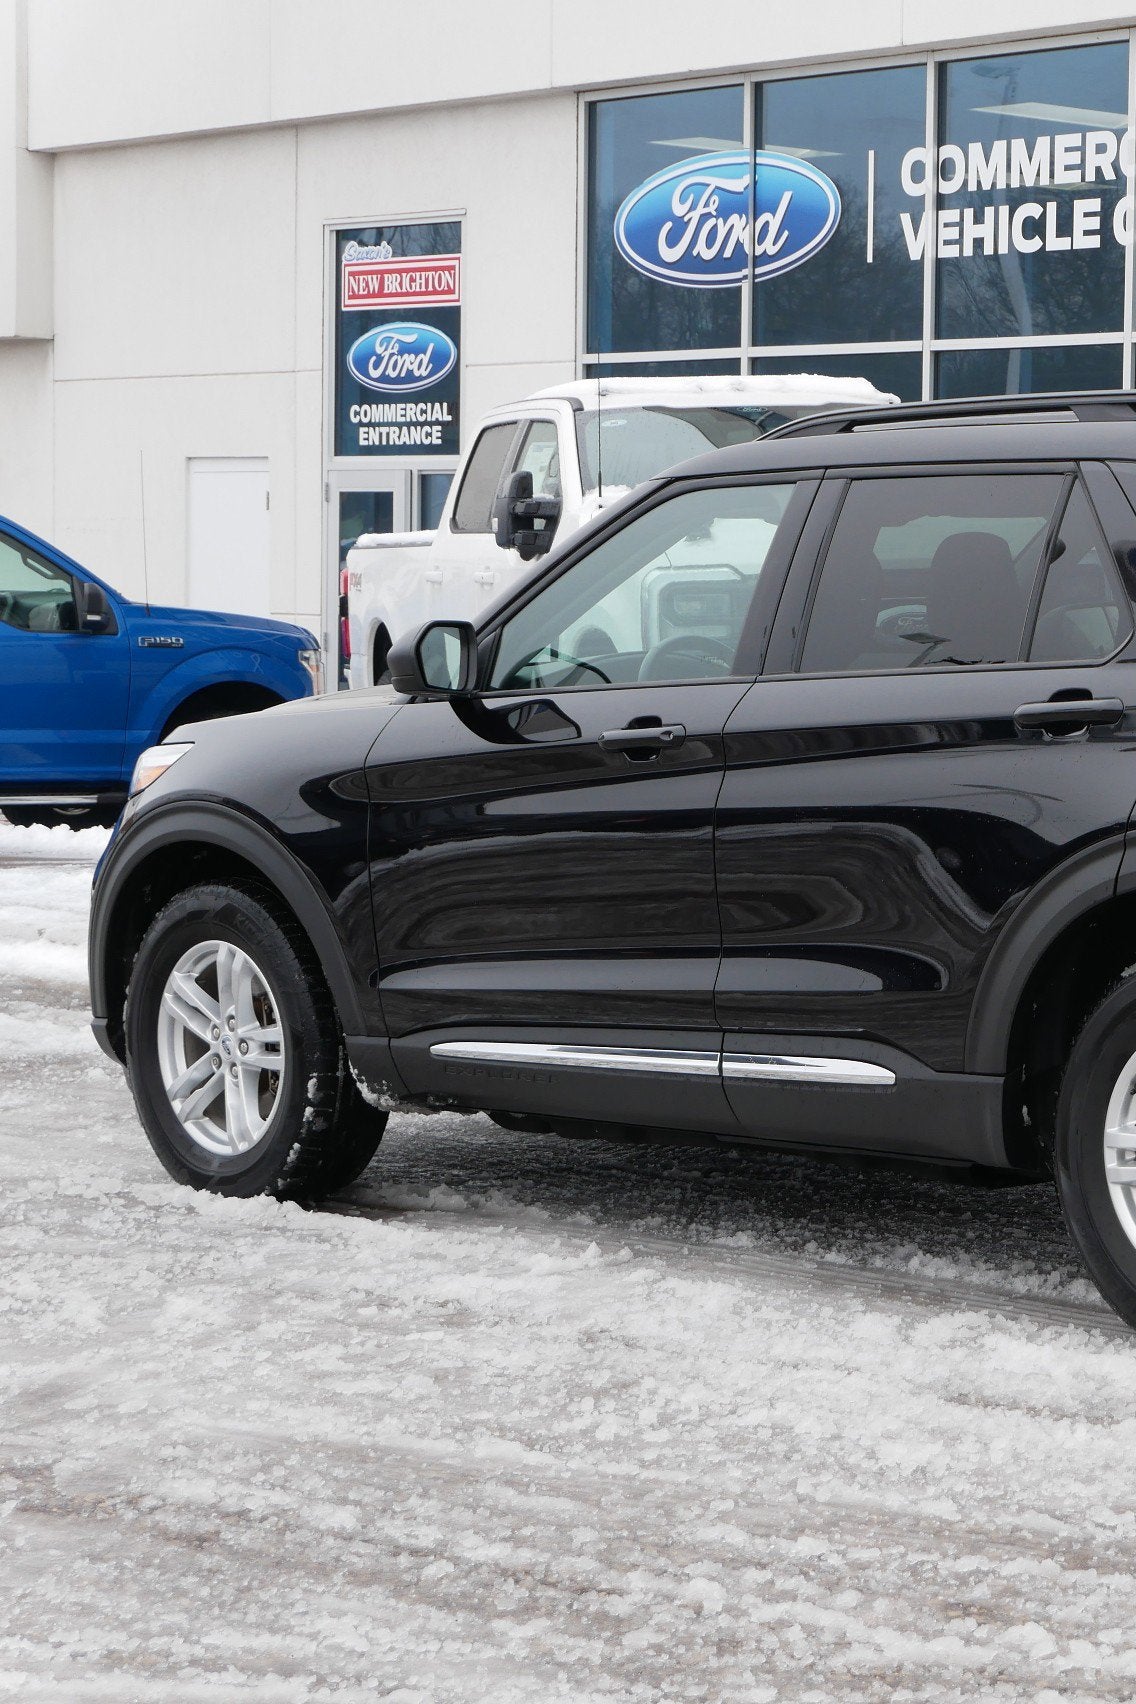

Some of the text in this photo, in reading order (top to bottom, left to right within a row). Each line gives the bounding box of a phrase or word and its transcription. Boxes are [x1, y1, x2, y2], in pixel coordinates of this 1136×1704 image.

[658, 174, 793, 263] Ford
[900, 198, 1101, 261] VEHICLE
[349, 269, 455, 295] NEW BRIGHTON
[368, 332, 434, 379] Ford
[350, 402, 452, 423] COMMERCIAL
[359, 425, 442, 446] ENTRANCE
